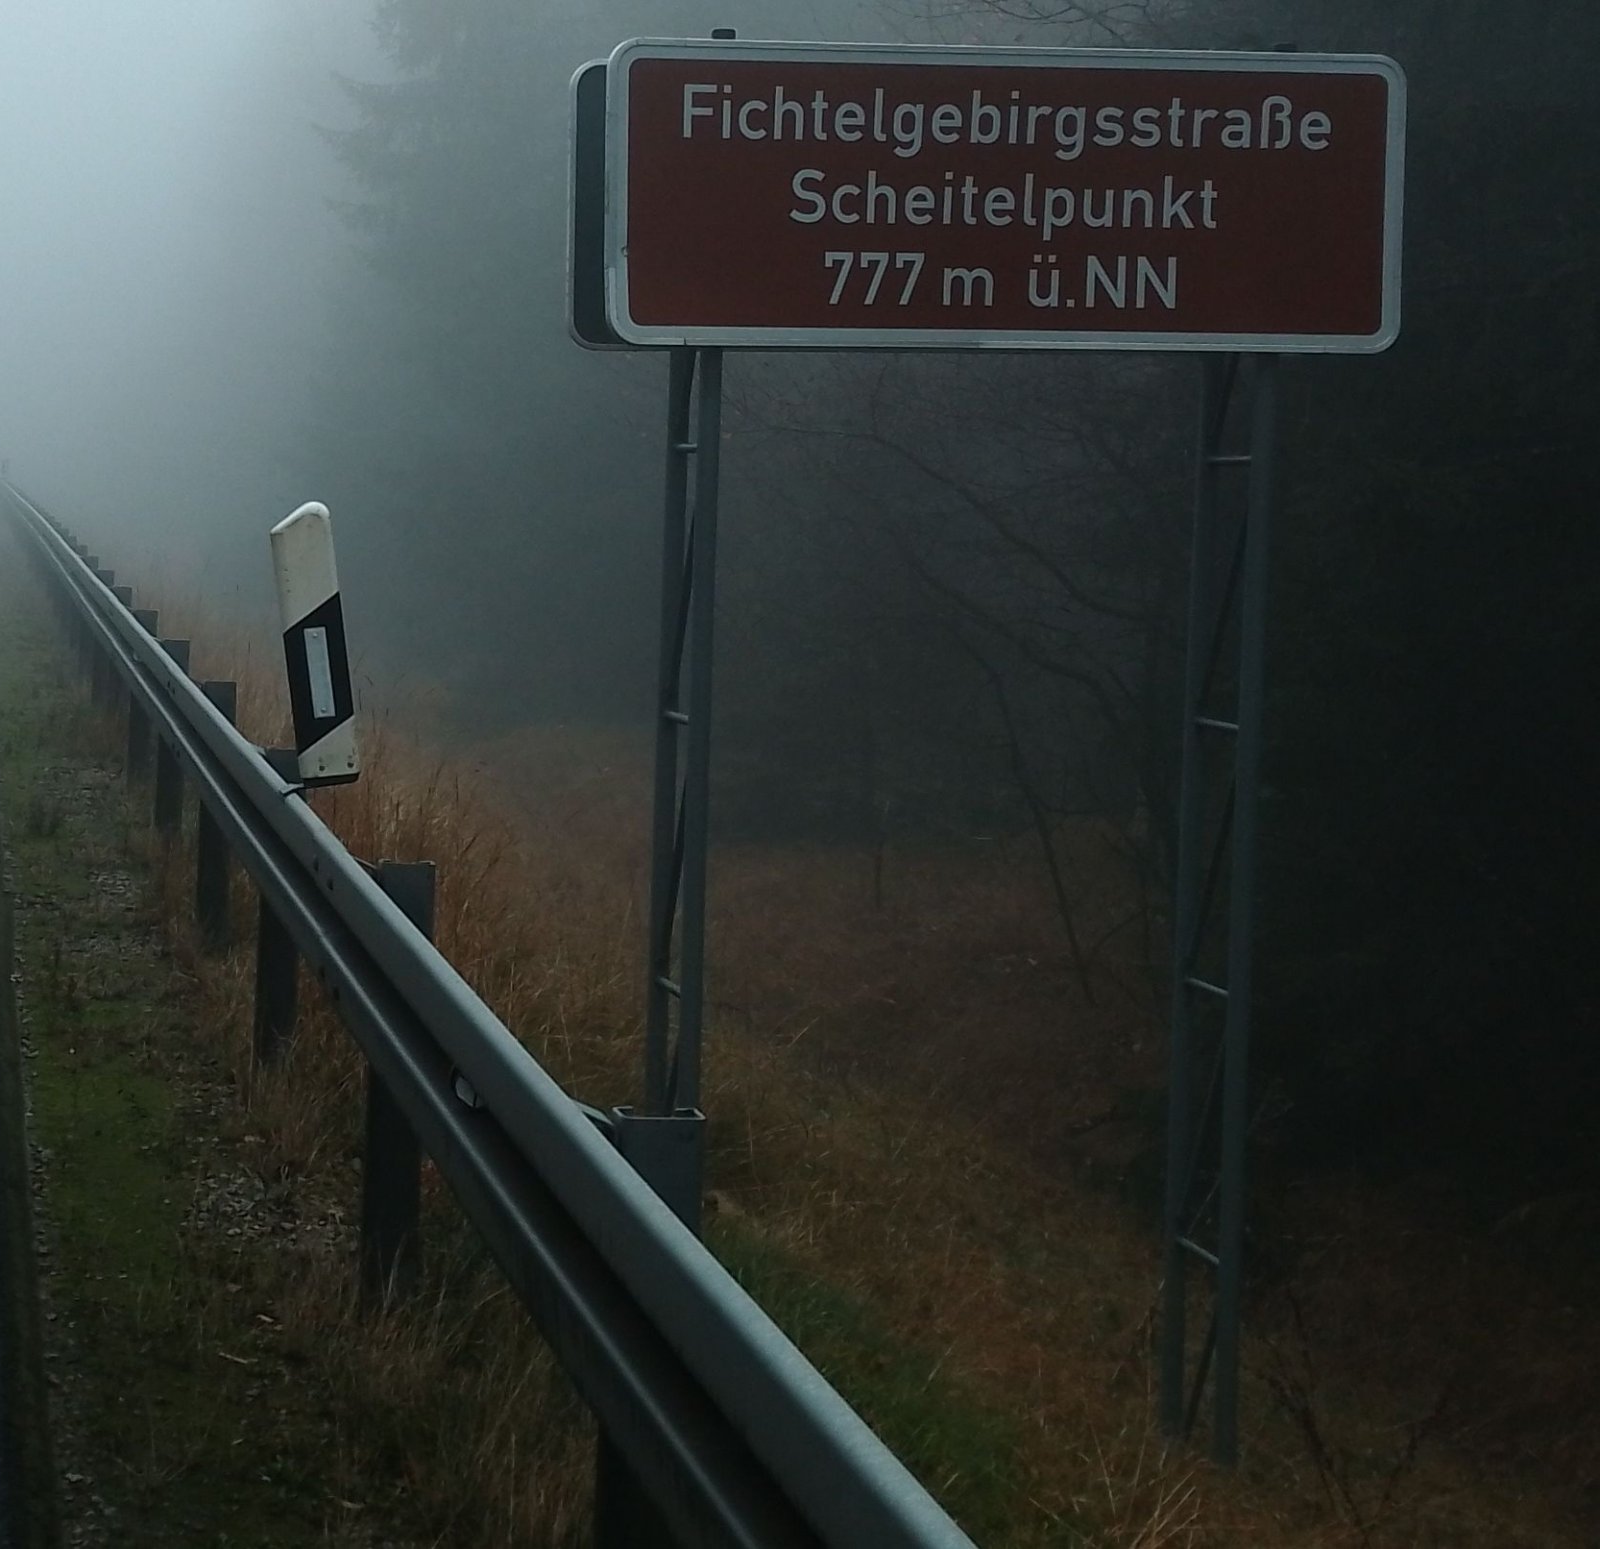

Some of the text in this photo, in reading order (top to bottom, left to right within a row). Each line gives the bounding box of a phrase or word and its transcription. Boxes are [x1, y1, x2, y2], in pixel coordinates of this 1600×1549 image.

[682, 83, 1332, 159] Fichtelgebirgsstraße
[789, 169, 1218, 241] Scheitelpunkt
[824, 252, 1177, 309] 777 m ü.NN
